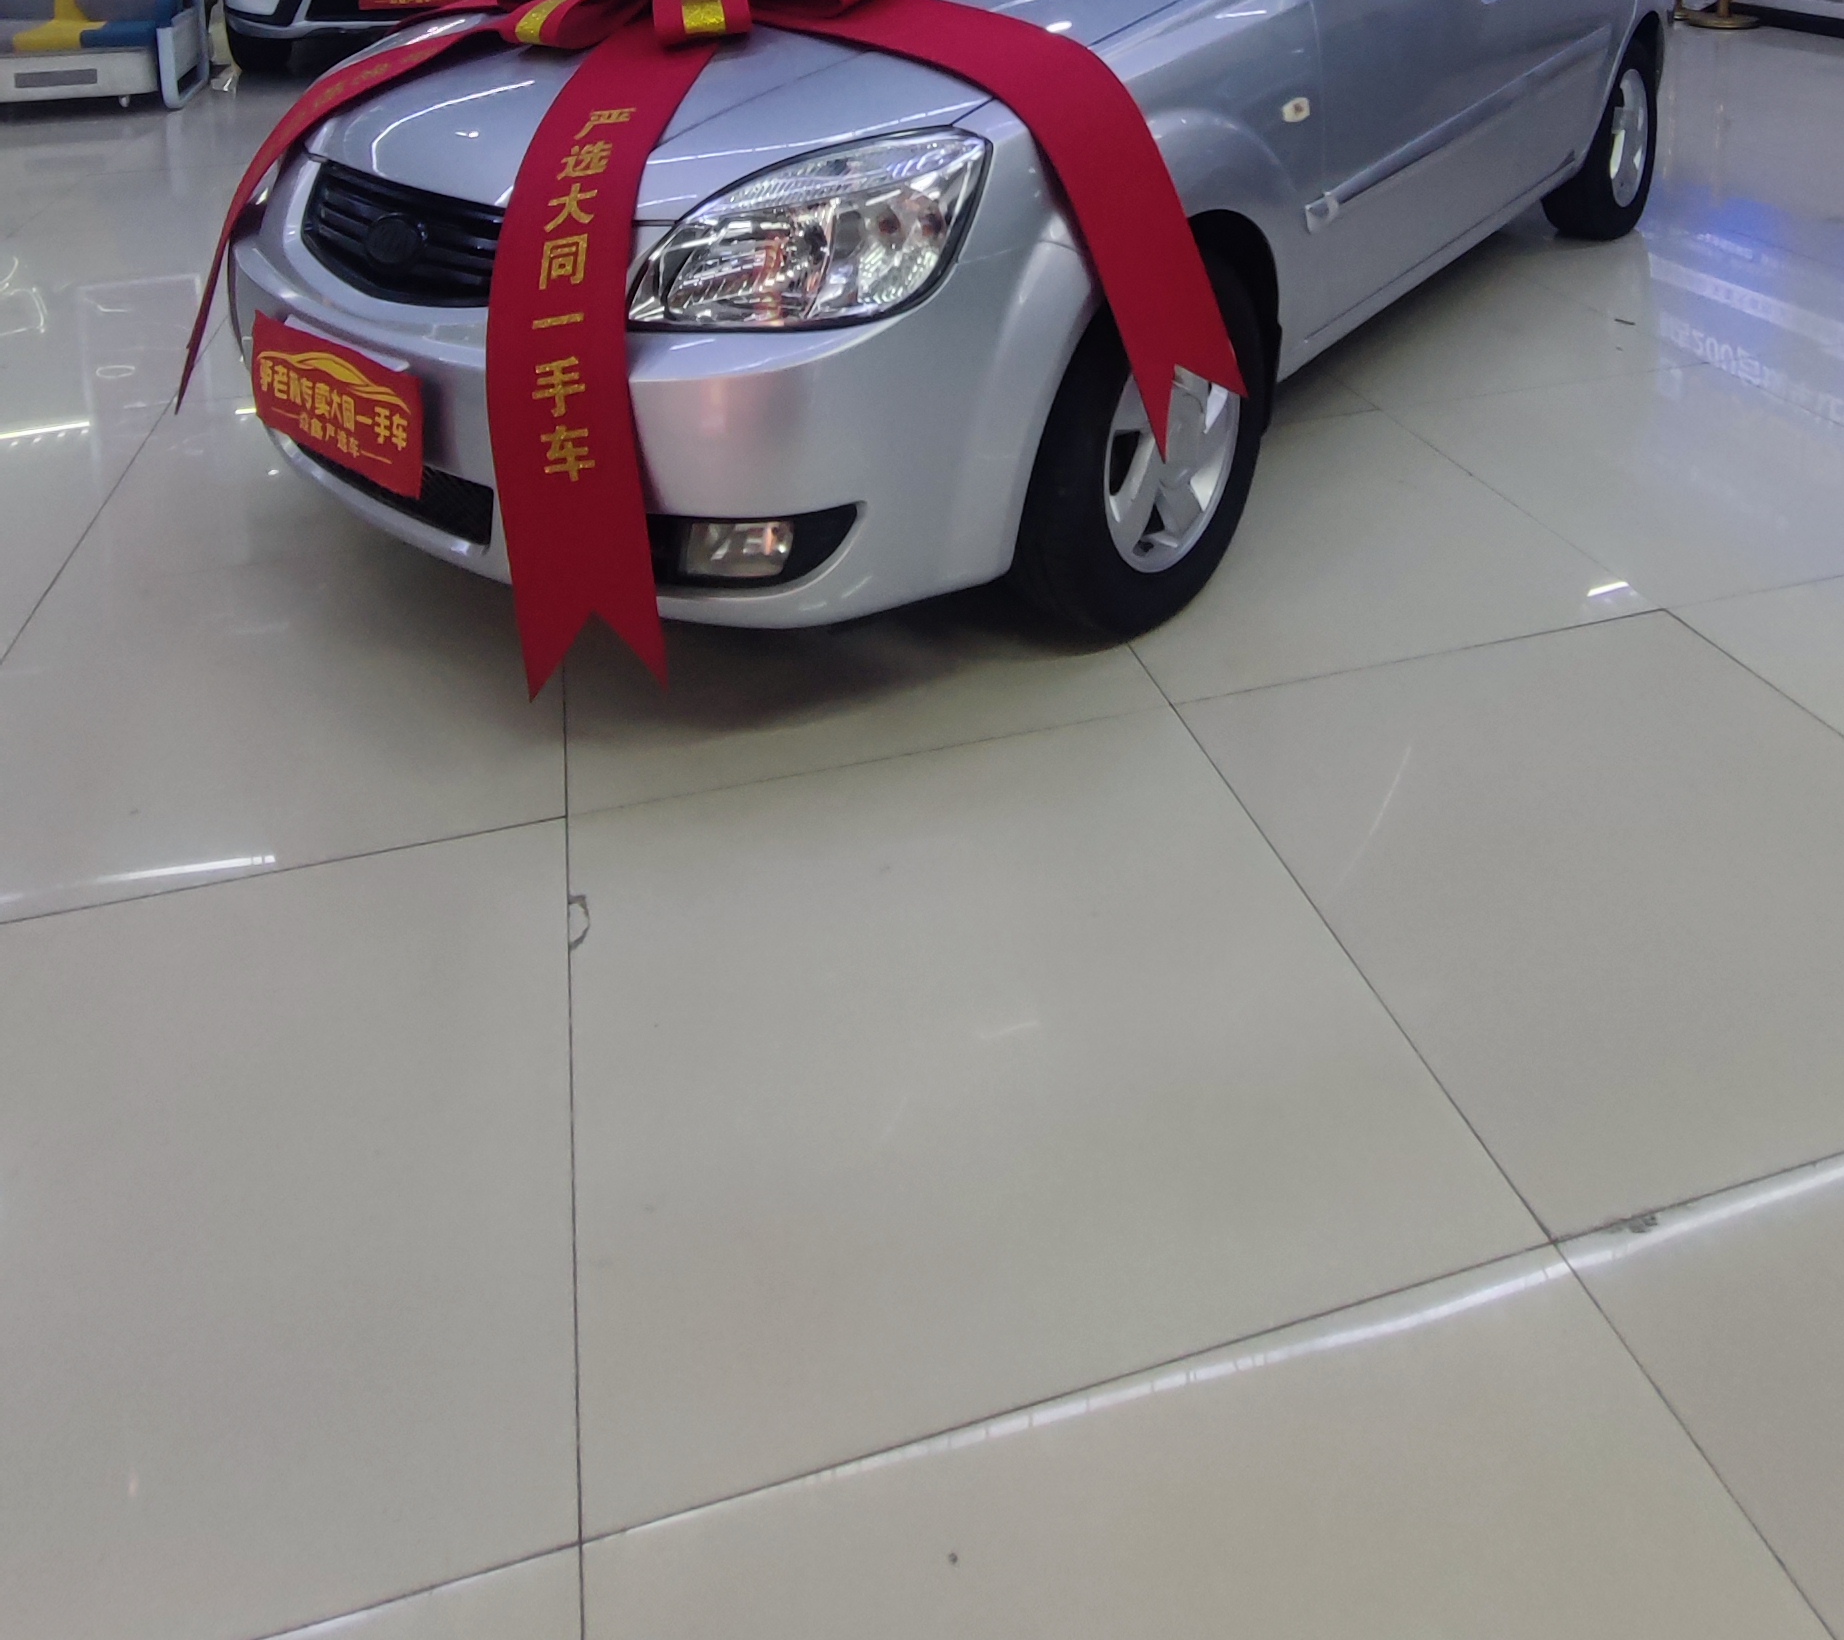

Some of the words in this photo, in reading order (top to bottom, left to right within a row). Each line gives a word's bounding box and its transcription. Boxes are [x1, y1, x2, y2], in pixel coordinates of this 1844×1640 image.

[532, 108, 636, 482] 严选大同一手车
